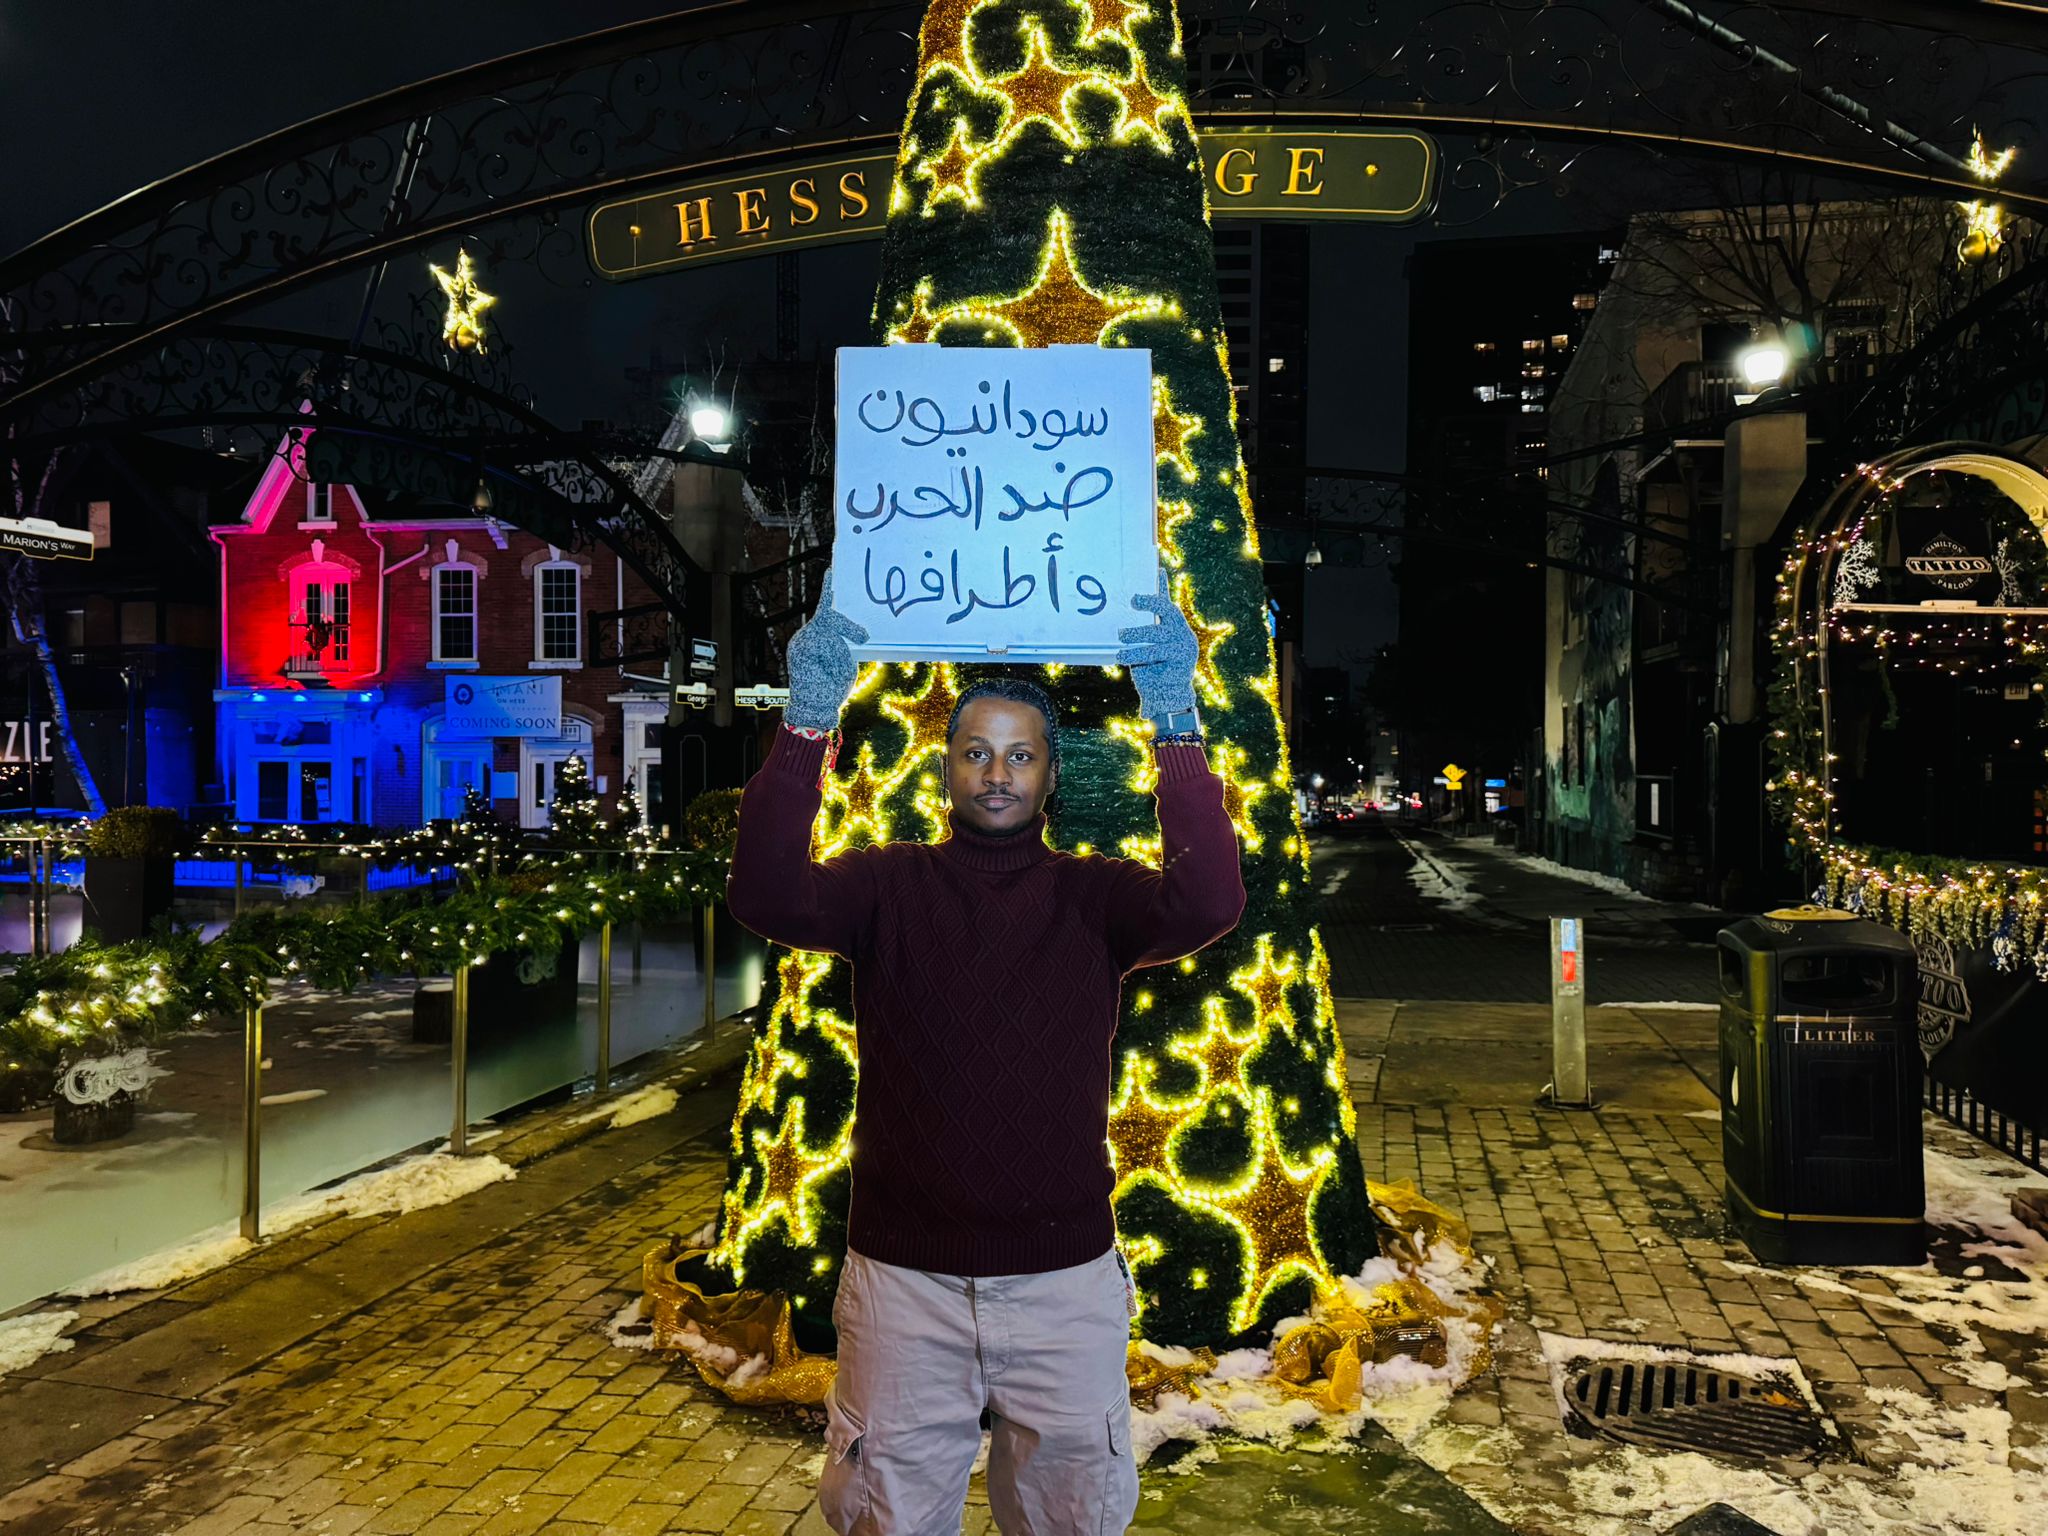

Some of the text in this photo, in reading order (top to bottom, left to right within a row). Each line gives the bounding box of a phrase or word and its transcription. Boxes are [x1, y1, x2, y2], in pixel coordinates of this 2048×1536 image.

[672, 147, 1325, 246] HESS GE
[858, 379, 1109, 458] سودانيون
[846, 461, 1114, 535] ضد الحرب
[3, 533, 76, 552] MARION'S WAY
[1925, 541, 1963, 554] HAMILTON
[1910, 559, 1985, 572] TATTOO
[864, 532, 1108, 625] وأطرافها
[1937, 577, 1974, 590] PARLOUR
[738, 696, 757, 704] HESS
[450, 717, 511, 729] COMING
[515, 717, 557, 729] SOON
[0, 721, 53, 762] ZIE
[1921, 975, 1961, 1012] TOO
[1804, 1030, 1875, 1041] LITTER
